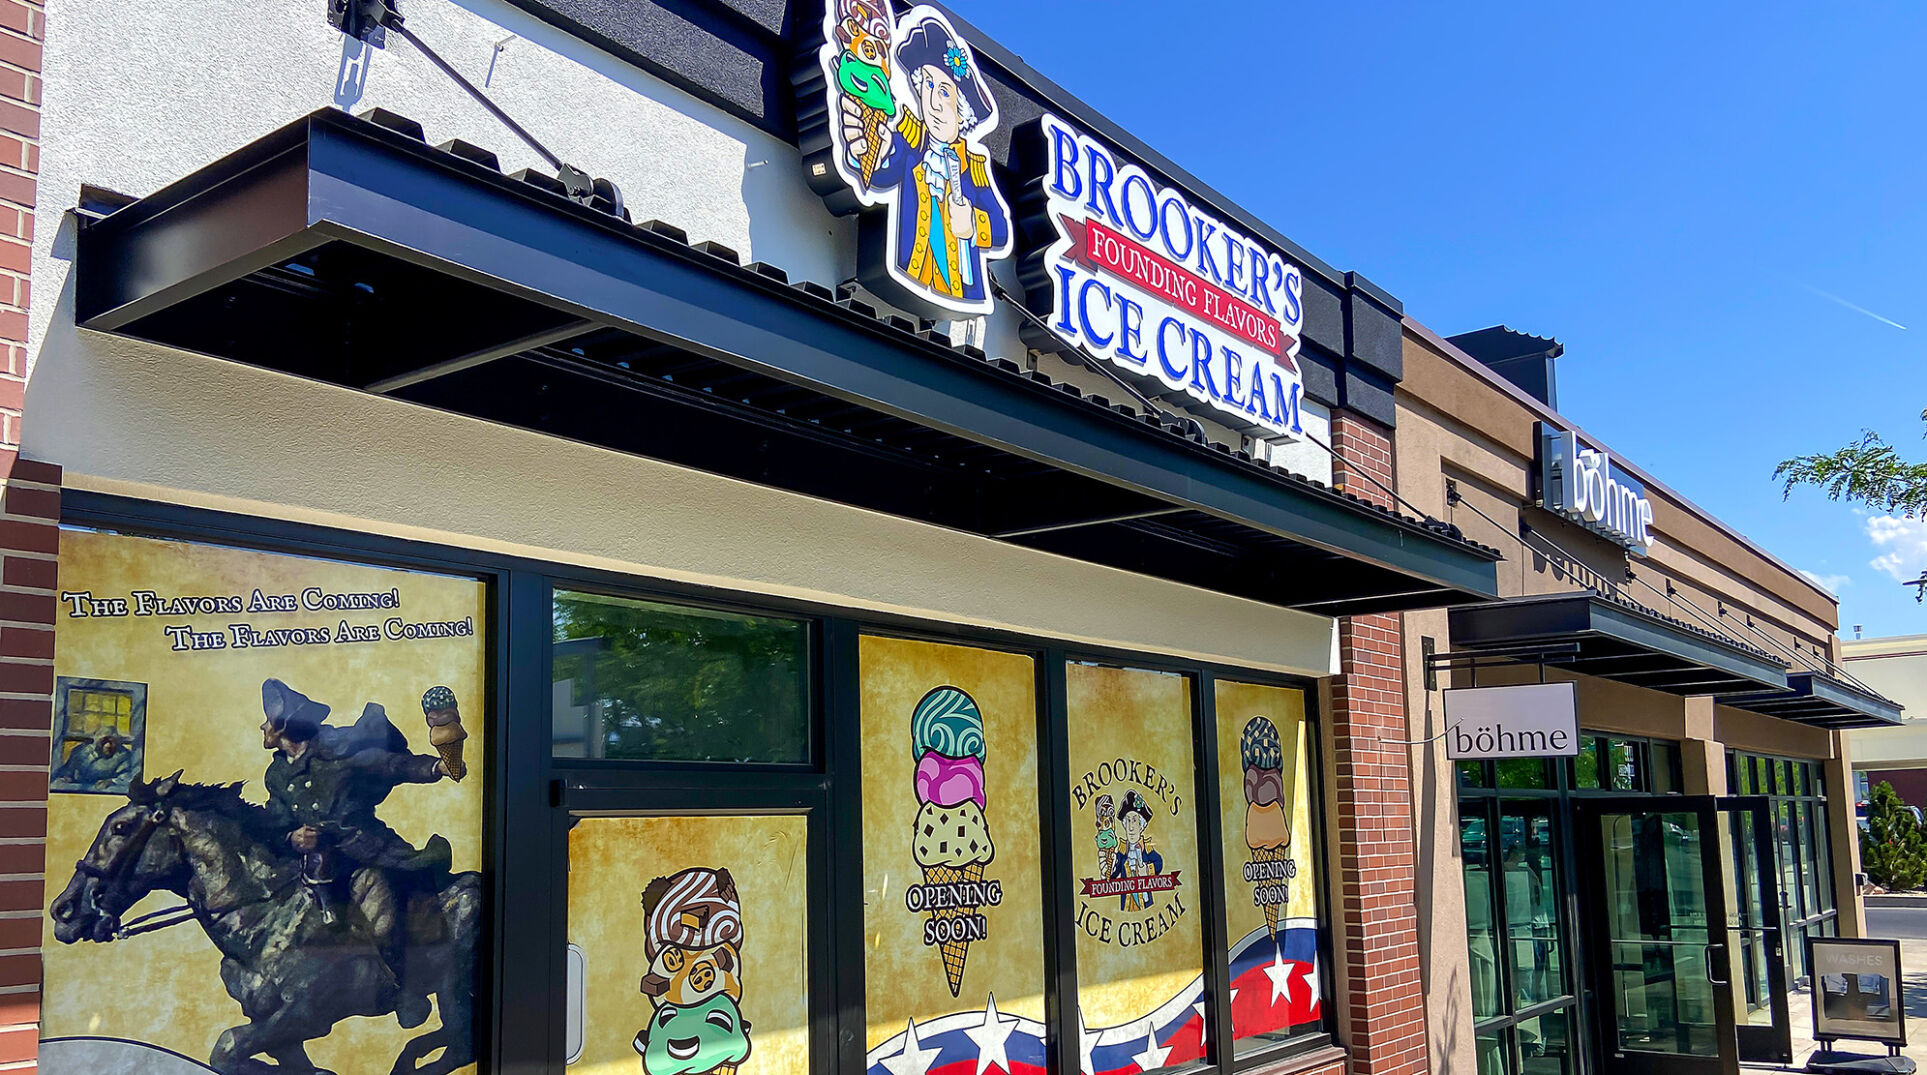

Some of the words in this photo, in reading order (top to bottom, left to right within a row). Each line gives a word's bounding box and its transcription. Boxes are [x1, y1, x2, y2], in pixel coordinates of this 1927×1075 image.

[1050, 123, 1300, 326] BROOKER'S
[1092, 227, 1197, 307] FOUNDING
[1203, 288, 1277, 348] FLAVORS
[1055, 263, 1148, 365] ICE
[1156, 316, 1303, 433] CREAM
[1568, 431, 1654, 546] böhme
[1455, 724, 1568, 754] böhme
[1071, 758, 1182, 816] BROOKER'S
[1091, 880, 1135, 895] FOUNDING
[1137, 876, 1172, 891] FLAVORS
[1243, 860, 1296, 881] OPENING
[906, 880, 1003, 912] OPENING
[1254, 886, 1288, 906] SOON!
[924, 914, 987, 945] SOON!
[1075, 901, 1112, 944] ICE
[1118, 893, 1186, 947] CREAM
[1826, 953, 1883, 966] WASHES
